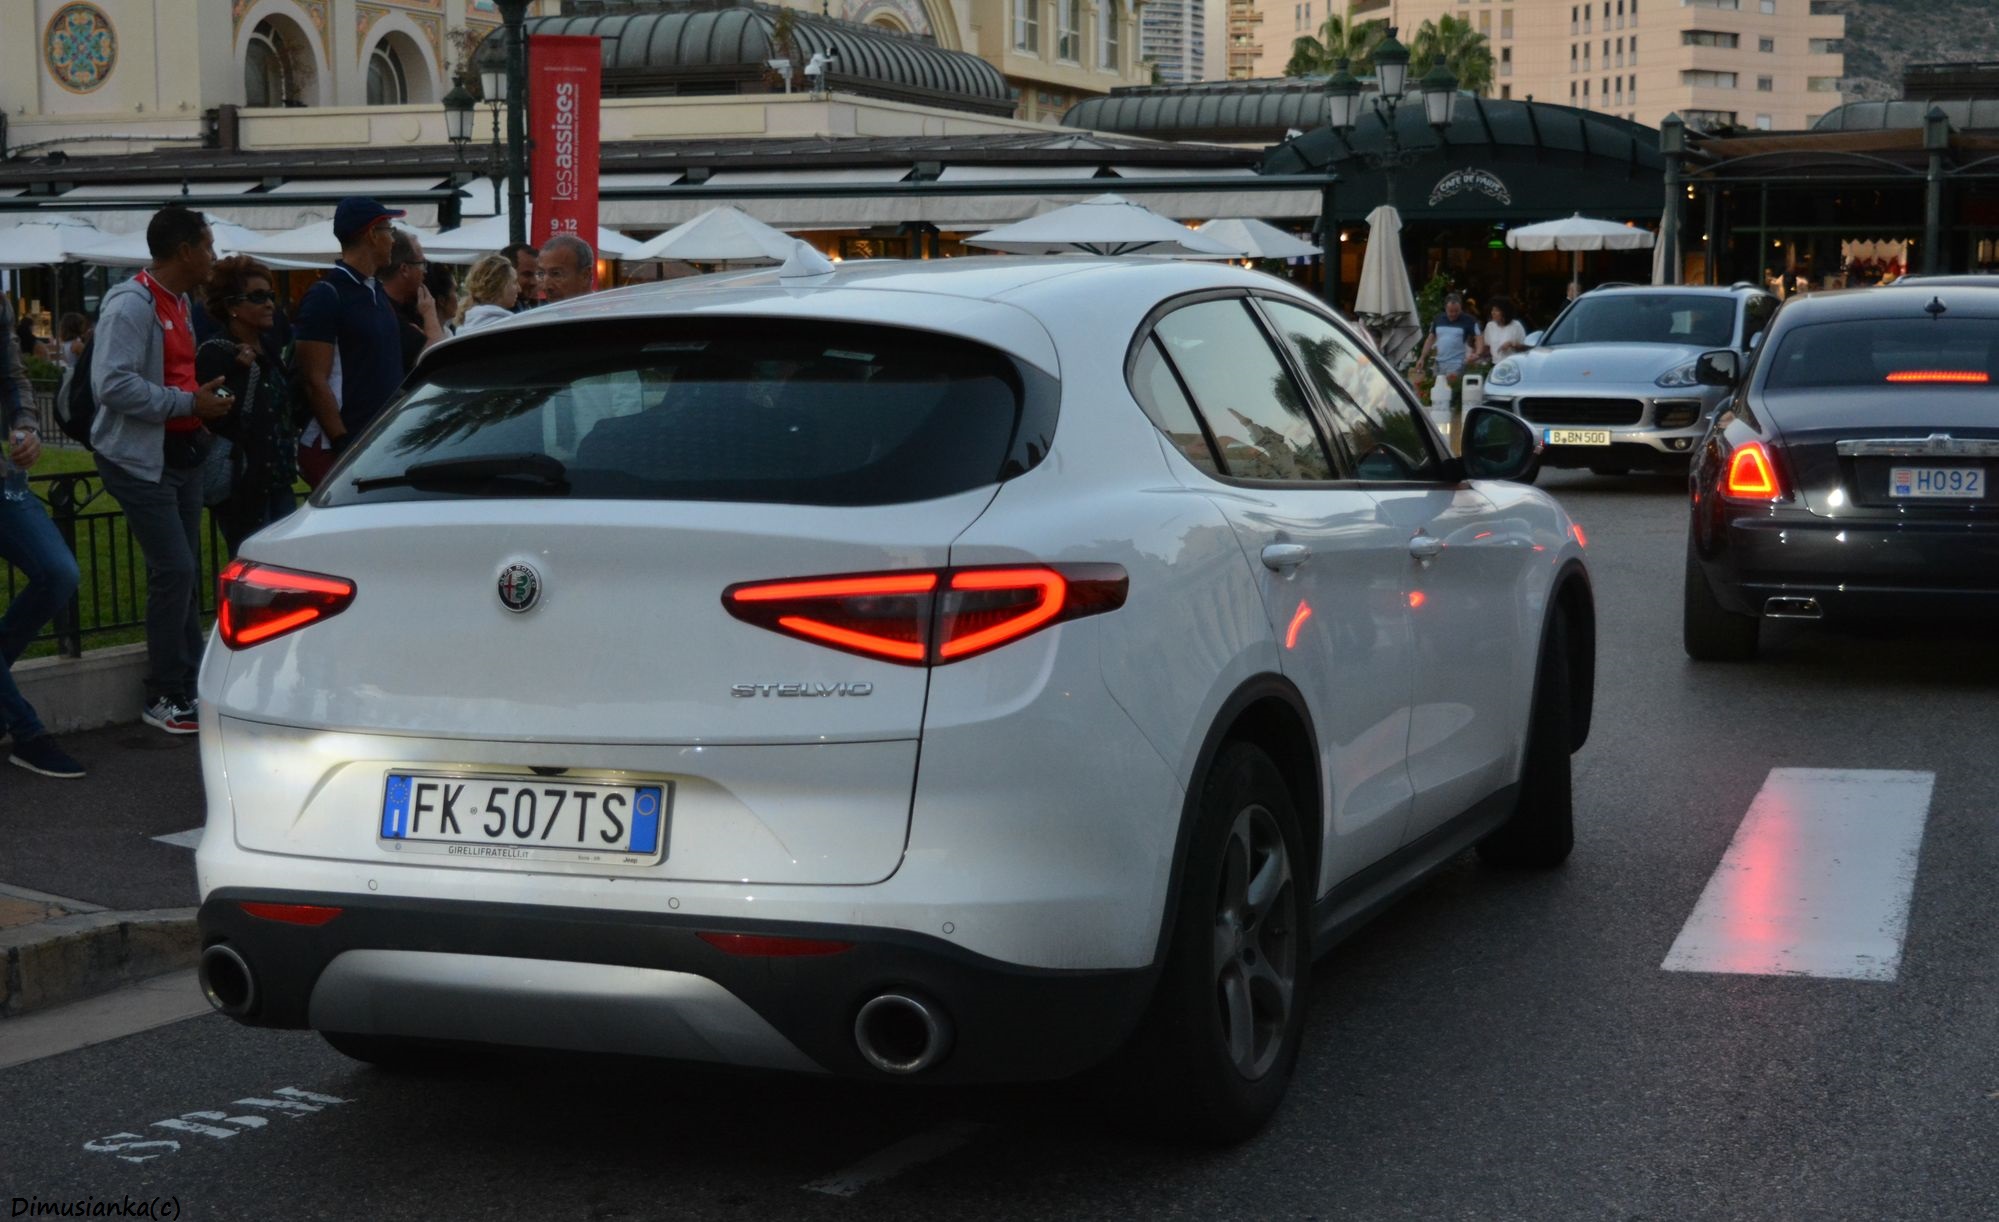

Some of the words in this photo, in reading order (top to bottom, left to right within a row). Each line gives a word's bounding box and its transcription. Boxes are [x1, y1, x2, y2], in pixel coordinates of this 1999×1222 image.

[1463, 175, 1474, 183] DE
[1475, 176, 1501, 191] PARIS
[1917, 471, 1978, 491] H092
[515, 565, 537, 588] ROMEO
[730, 682, 873, 698] STELVIO
[413, 783, 464, 834] FK
[483, 787, 626, 844] 507TS
